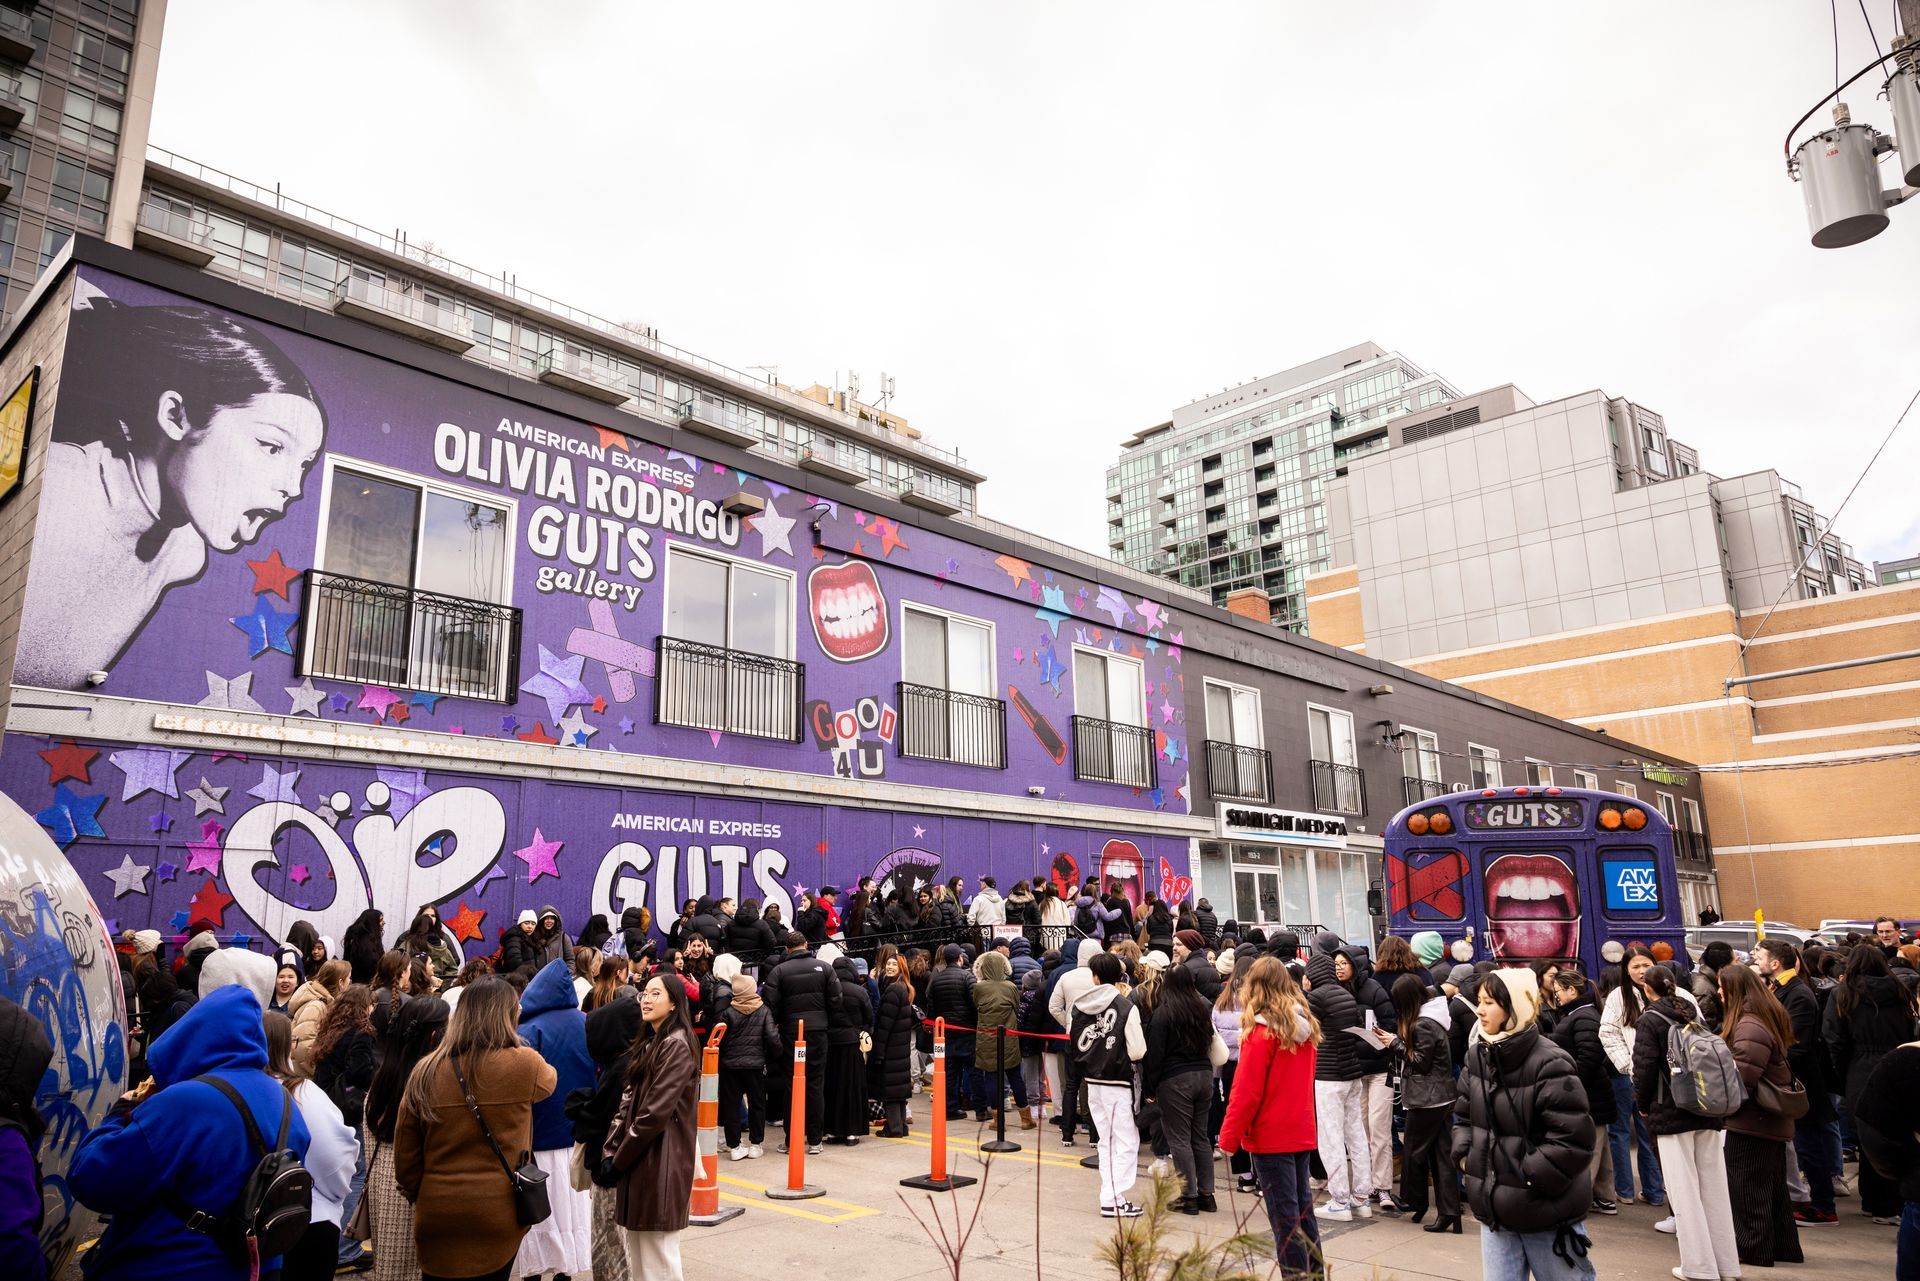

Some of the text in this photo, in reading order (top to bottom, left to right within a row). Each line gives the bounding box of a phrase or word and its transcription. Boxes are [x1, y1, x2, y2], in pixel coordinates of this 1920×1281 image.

[496, 417, 695, 489] AMERICAN EXPRESS
[434, 423, 740, 547] OLIVIA RODRIGO
[527, 505, 655, 580] GUTS
[536, 565, 642, 611] gallery
[813, 698, 895, 742] GOOD
[611, 813, 782, 839] AMERICAN EXPRESS
[1295, 818, 1325, 834] MED
[1324, 820, 1348, 836] SPA
[1486, 803, 1563, 828] GUTS
[591, 841, 795, 935] GUTS
[1624, 885, 1658, 902] EX
